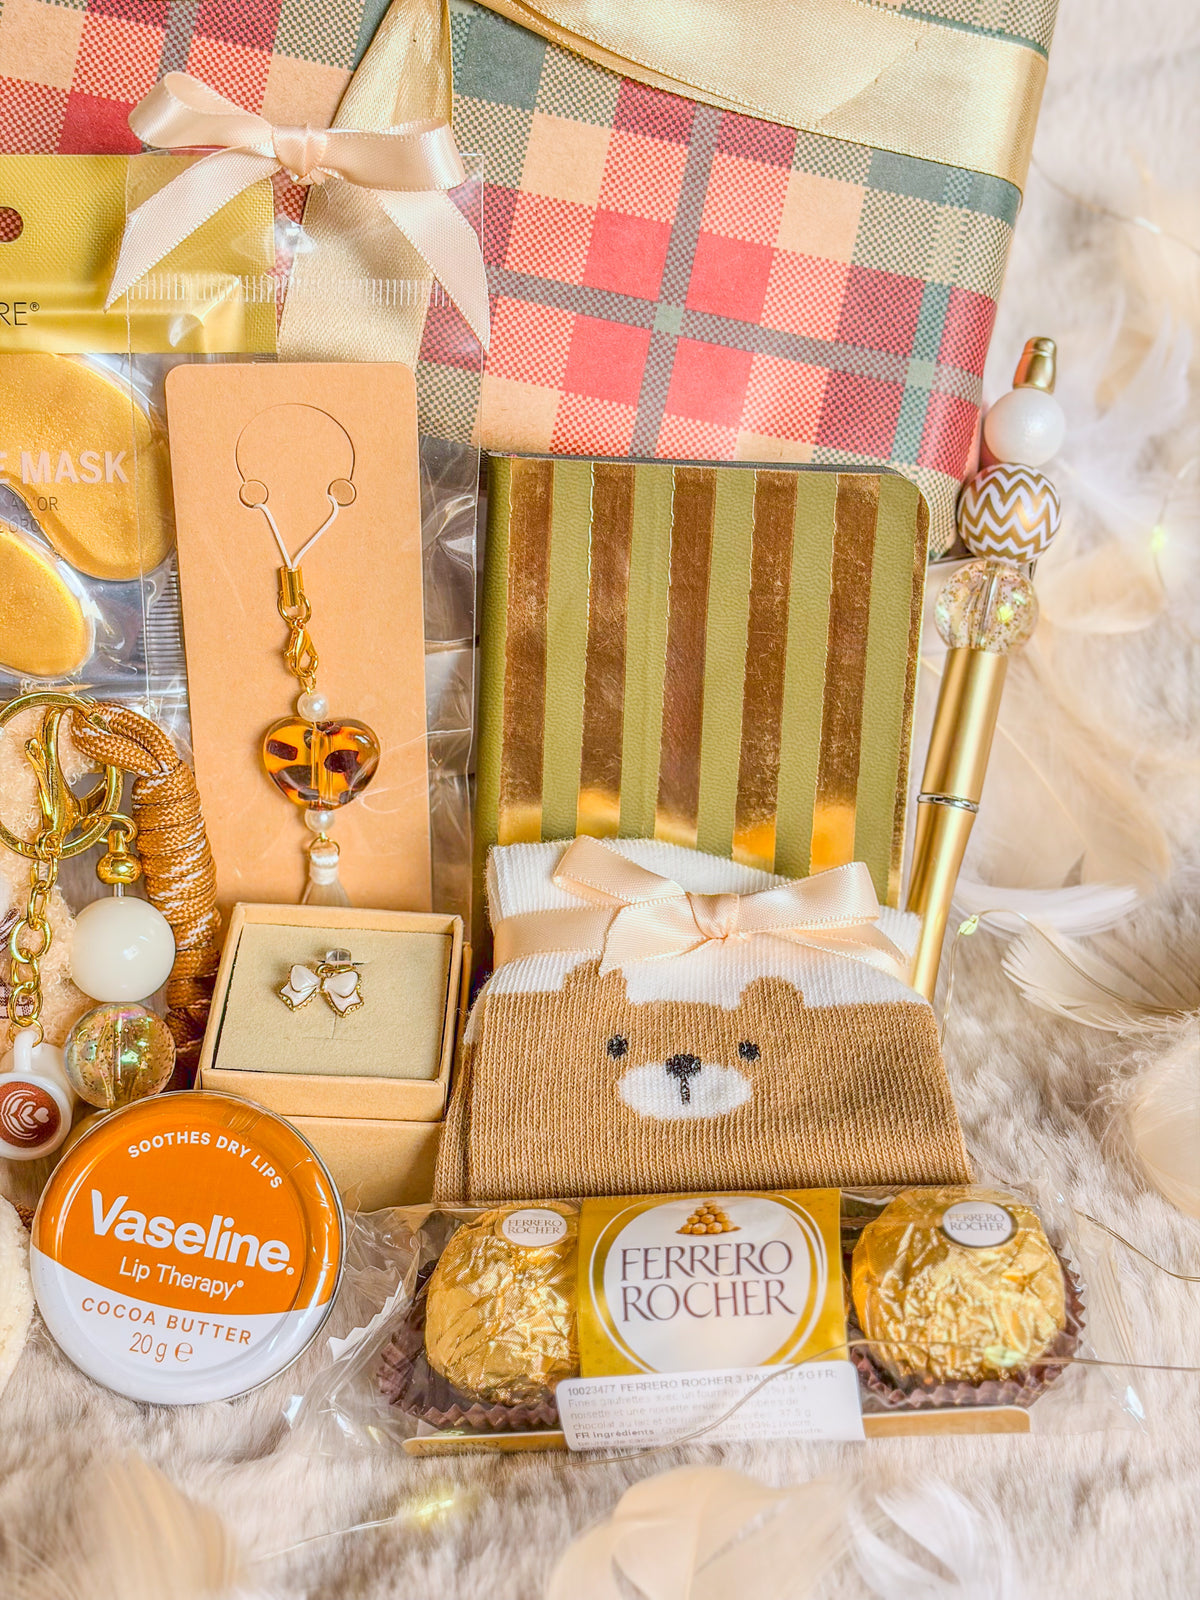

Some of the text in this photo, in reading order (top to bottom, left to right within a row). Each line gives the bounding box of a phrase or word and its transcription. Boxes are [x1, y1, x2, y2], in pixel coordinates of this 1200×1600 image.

[21, 451, 129, 484] MASK
[128, 1131, 283, 1188] SOOTHES DRY LIPS
[507, 1226, 560, 1234] ROCHER
[508, 1219, 563, 1227] FERRERO
[948, 1213, 1005, 1222] FERRERO
[950, 1221, 1006, 1232] ROCHER
[119, 1256, 151, 1283] Lip
[620, 1240, 793, 1282] FERRERO
[622, 1279, 798, 1322] ROCHER
[82, 1297, 252, 1345] COCOA BUTTER
[620, 1379, 678, 1392] FERRERO
[681, 1375, 732, 1387] ROCHER
